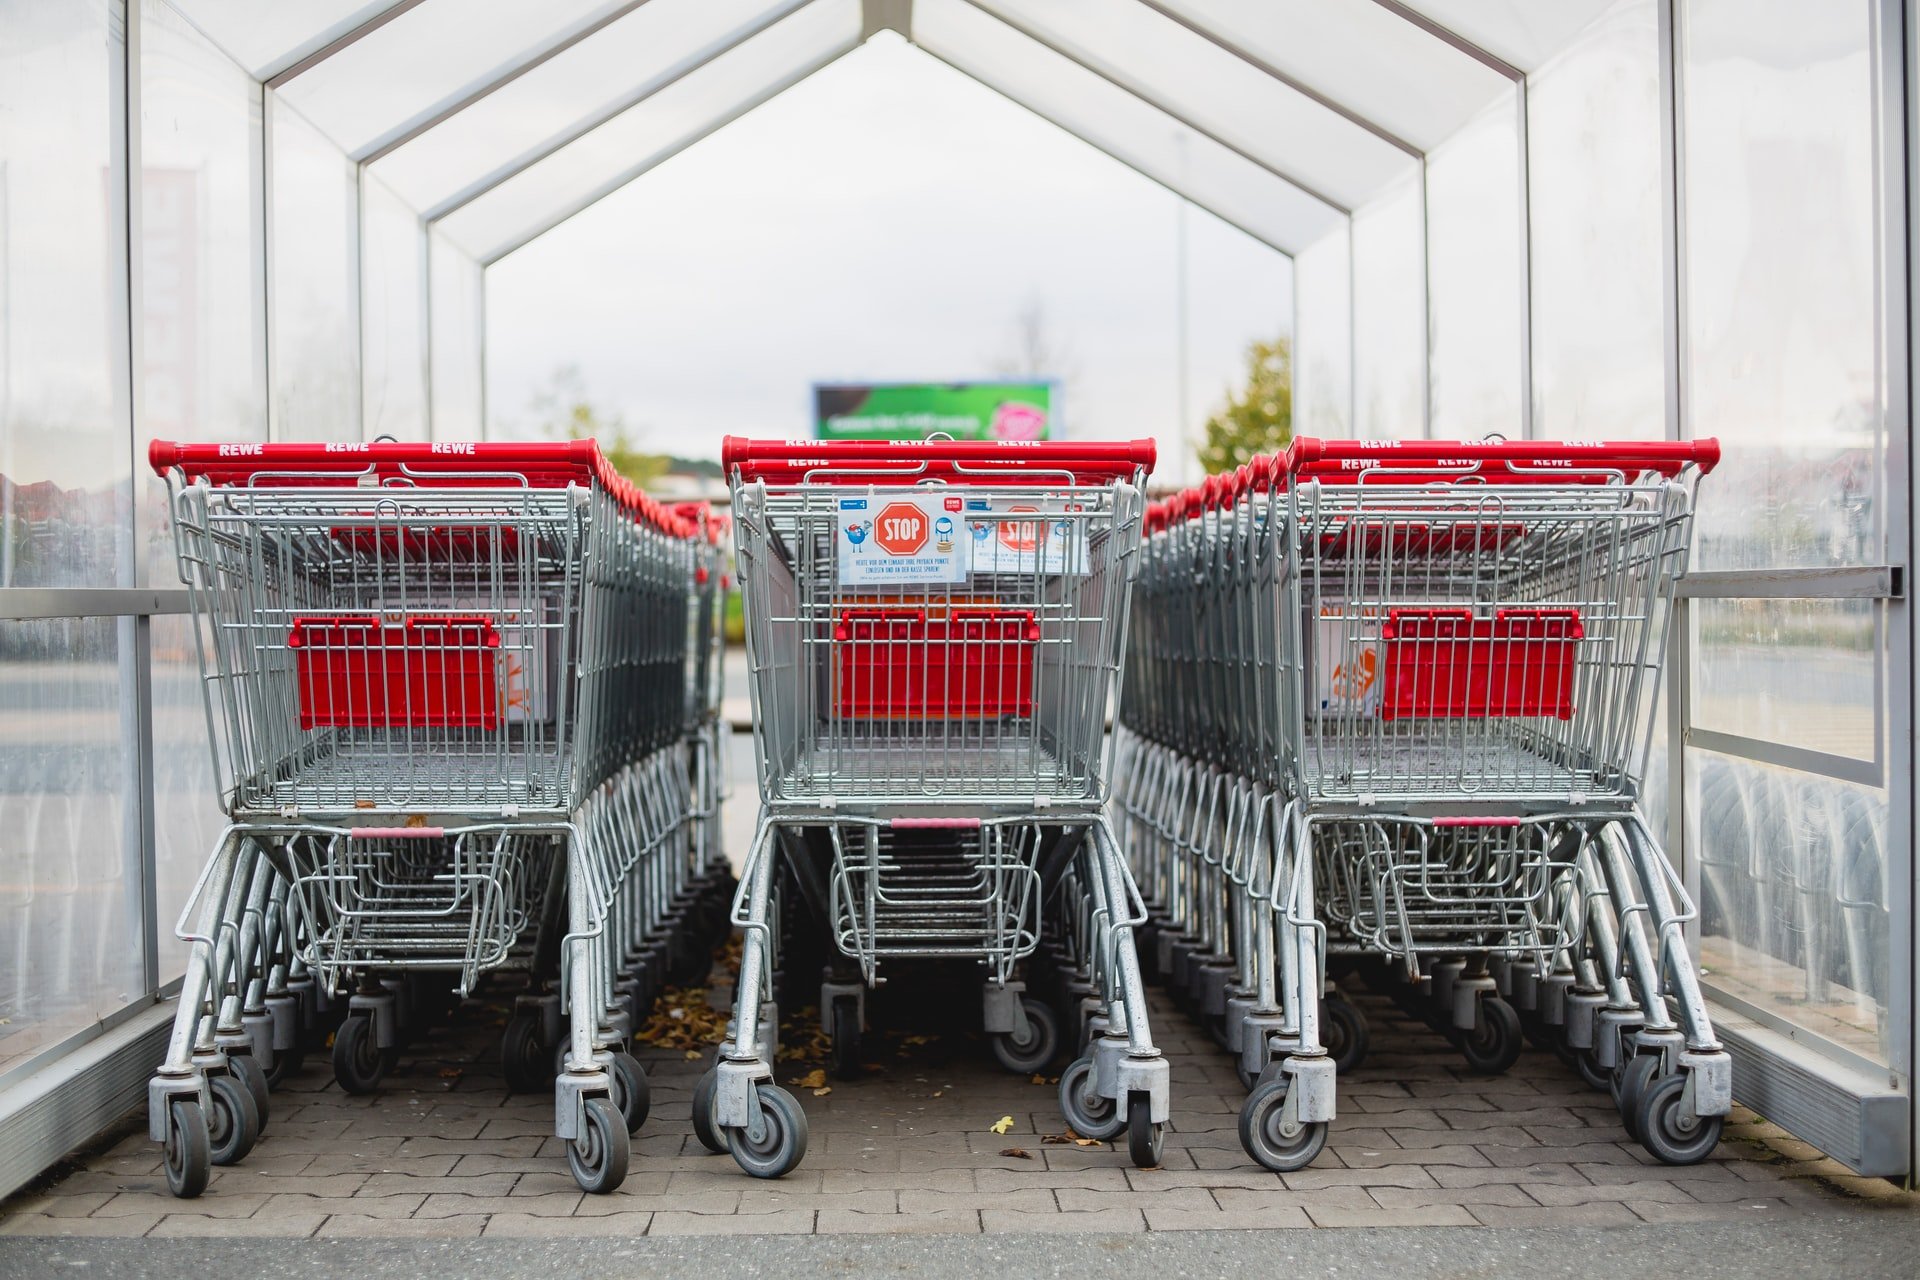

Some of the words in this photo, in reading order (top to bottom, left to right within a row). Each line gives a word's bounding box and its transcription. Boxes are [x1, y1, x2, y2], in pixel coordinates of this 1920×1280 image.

[219, 443, 263, 456] REWE
[325, 442, 369, 452] REWE
[431, 442, 475, 454] REWE
[1360, 440, 1402, 448] REWE
[1341, 459, 1381, 470] REWE
[884, 518, 921, 541] STOP
